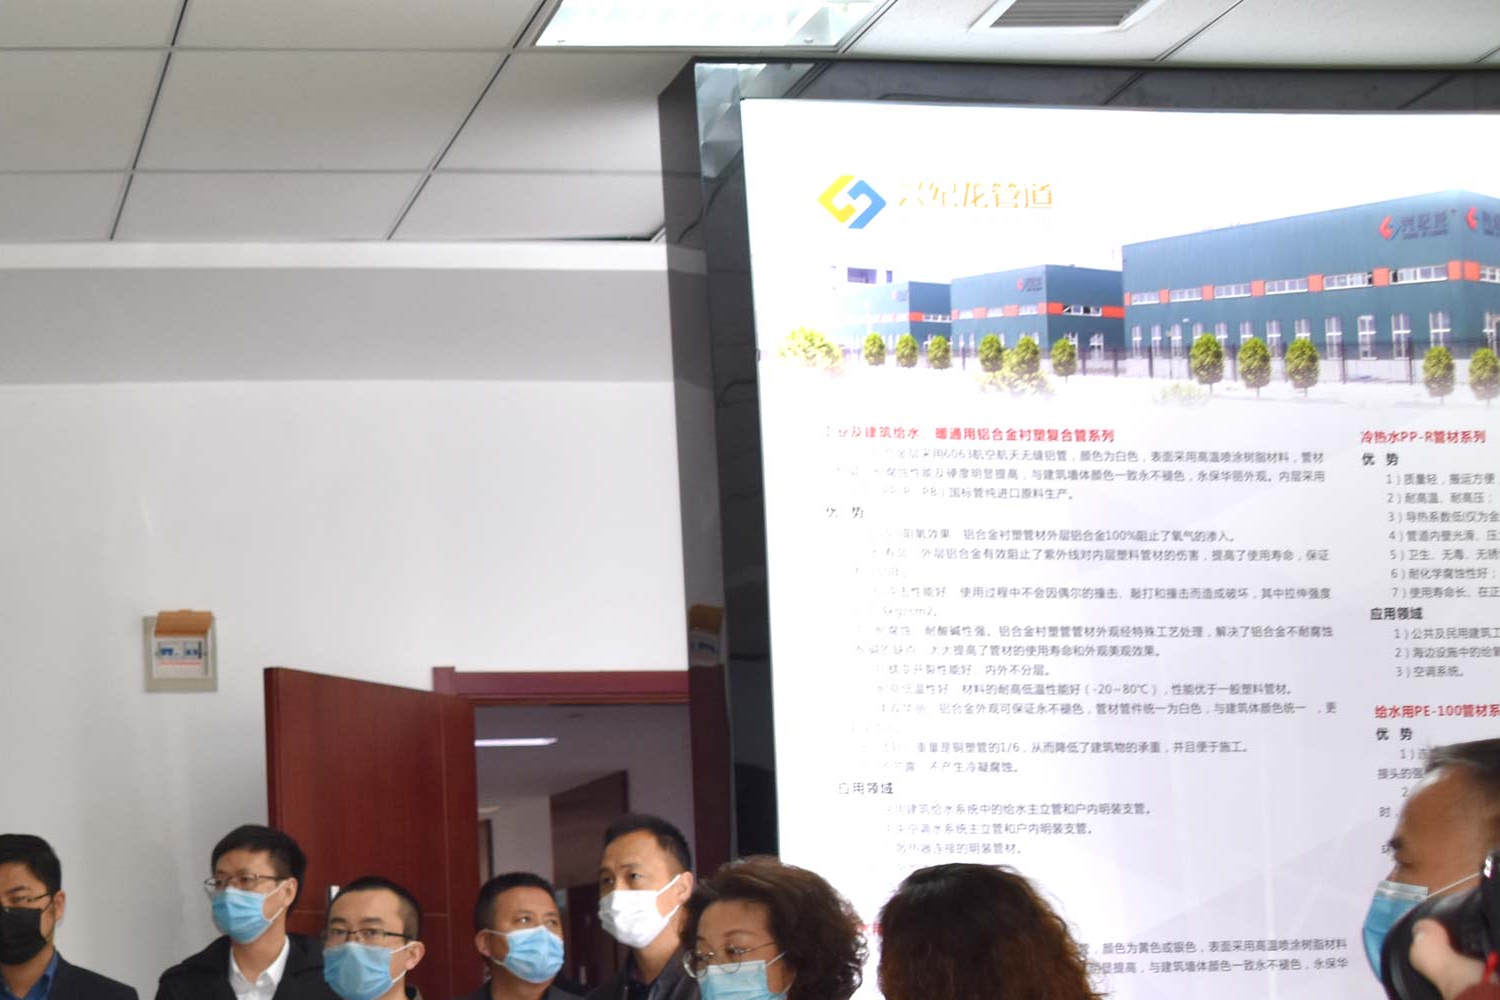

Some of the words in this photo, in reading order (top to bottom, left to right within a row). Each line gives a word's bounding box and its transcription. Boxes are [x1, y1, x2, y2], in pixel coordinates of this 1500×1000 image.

[1360, 429, 1487, 445] 冷热水PP-R管材系列
[1388, 548, 1500, 561] 5）卫生、无毒、无锈
[1370, 606, 1424, 621] 应用领域
